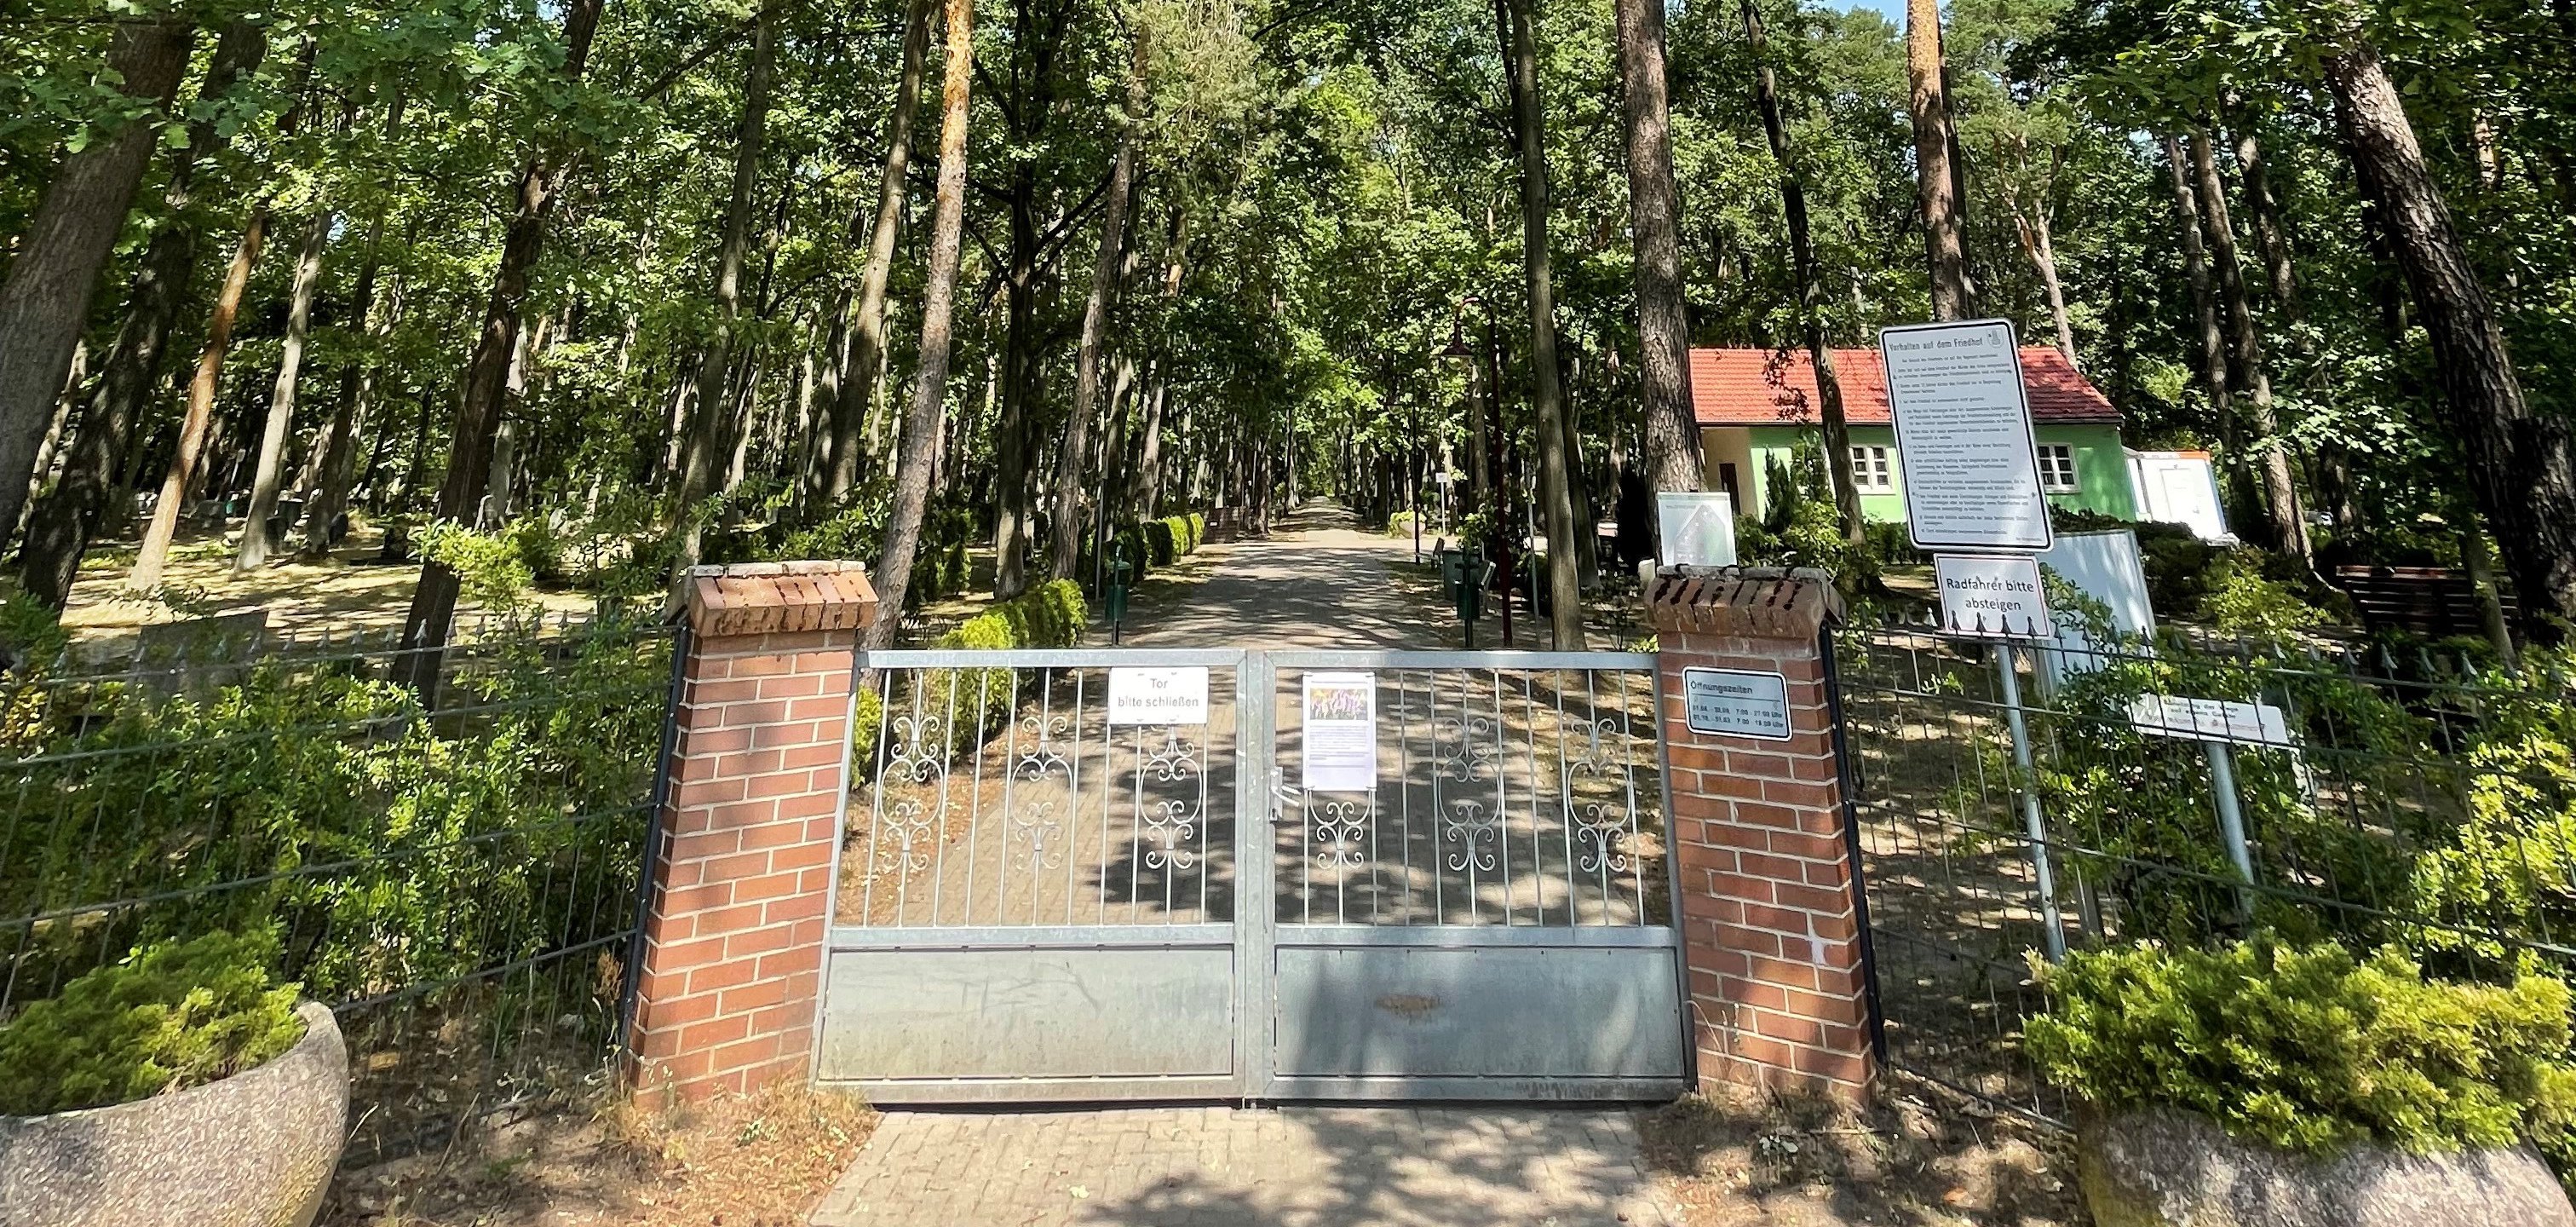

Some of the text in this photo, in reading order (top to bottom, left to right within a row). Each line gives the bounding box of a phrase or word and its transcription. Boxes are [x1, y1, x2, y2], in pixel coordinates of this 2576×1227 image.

[1889, 337, 1983, 351] Verhalten auf dem Friedhof
[1946, 578, 2034, 592] Radfahrer bitte
[1965, 597, 2021, 613] absteigen
[1150, 678, 1168, 688] Tor
[1118, 696, 1199, 707] bitte schließen
